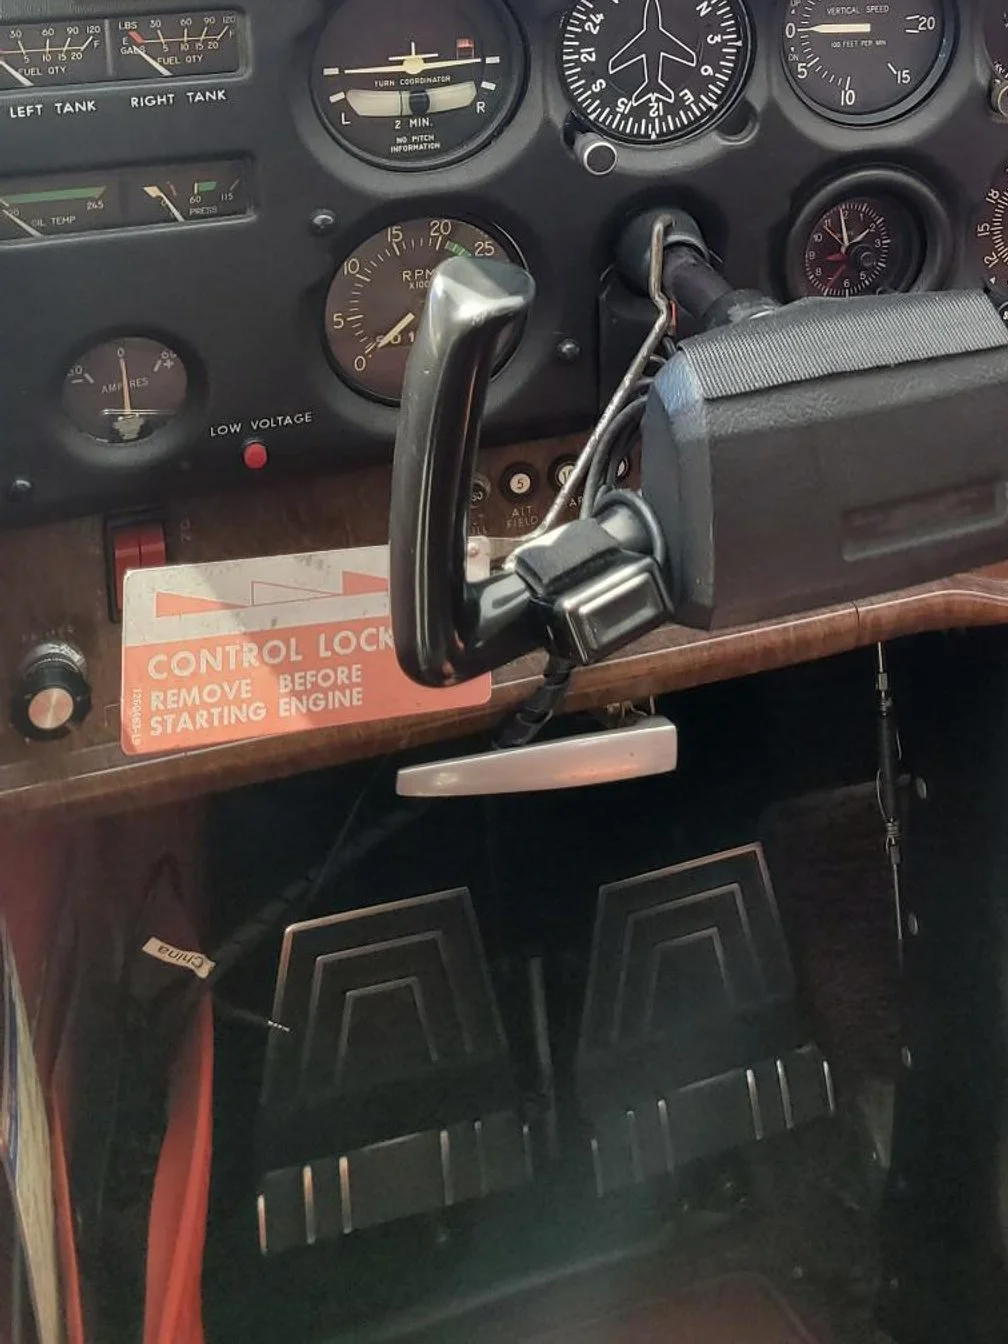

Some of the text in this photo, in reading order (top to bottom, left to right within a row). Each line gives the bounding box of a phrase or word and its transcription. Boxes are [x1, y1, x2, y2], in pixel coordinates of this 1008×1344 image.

[697, 1, 712, 16] N
[827, 5, 888, 14] VERTICAL SPEED
[42, 25, 100, 36] 60 90 120
[585, 13, 604, 34] 24
[787, 23, 795, 38] 0
[919, 18, 935, 31] 20
[708, 34, 721, 43] 3
[157, 55, 202, 65] FUEL QTY
[581, 47, 595, 62] 21
[701, 66, 713, 76] 6
[798, 64, 808, 78] 5
[898, 71, 911, 84] 15
[400, 75, 450, 86] COORDINATOR
[592, 79, 606, 91] S
[131, 90, 226, 108] RIGHT TANK
[679, 90, 694, 105] E
[841, 90, 855, 105] 10
[10, 100, 96, 118] LEFT TANK
[477, 102, 485, 113] R
[616, 98, 632, 114] 15
[649, 103, 663, 117] 12
[342, 113, 351, 124] L
[395, 117, 433, 129] 2 MIN.
[412, 134, 434, 142] PITCH
[391, 143, 440, 153] INFORMATION
[388, 227, 402, 242] 15
[431, 221, 451, 235] 20
[978, 224, 990, 236] 15
[475, 242, 495, 256] 25
[344, 259, 359, 274] 10
[333, 314, 344, 328] 5
[355, 356, 366, 371] 0
[210, 413, 312, 436] LOW VOLTAGE
[516, 477, 524, 490] 5
[511, 507, 532, 517] ALT
[148, 628, 394, 680] CONTROL LOCK
[150, 664, 362, 711] REMOVE BEFORE
[150, 703, 267, 736] STARTING
[279, 687, 363, 718] ENGINE
[158, 945, 202, 969] China
